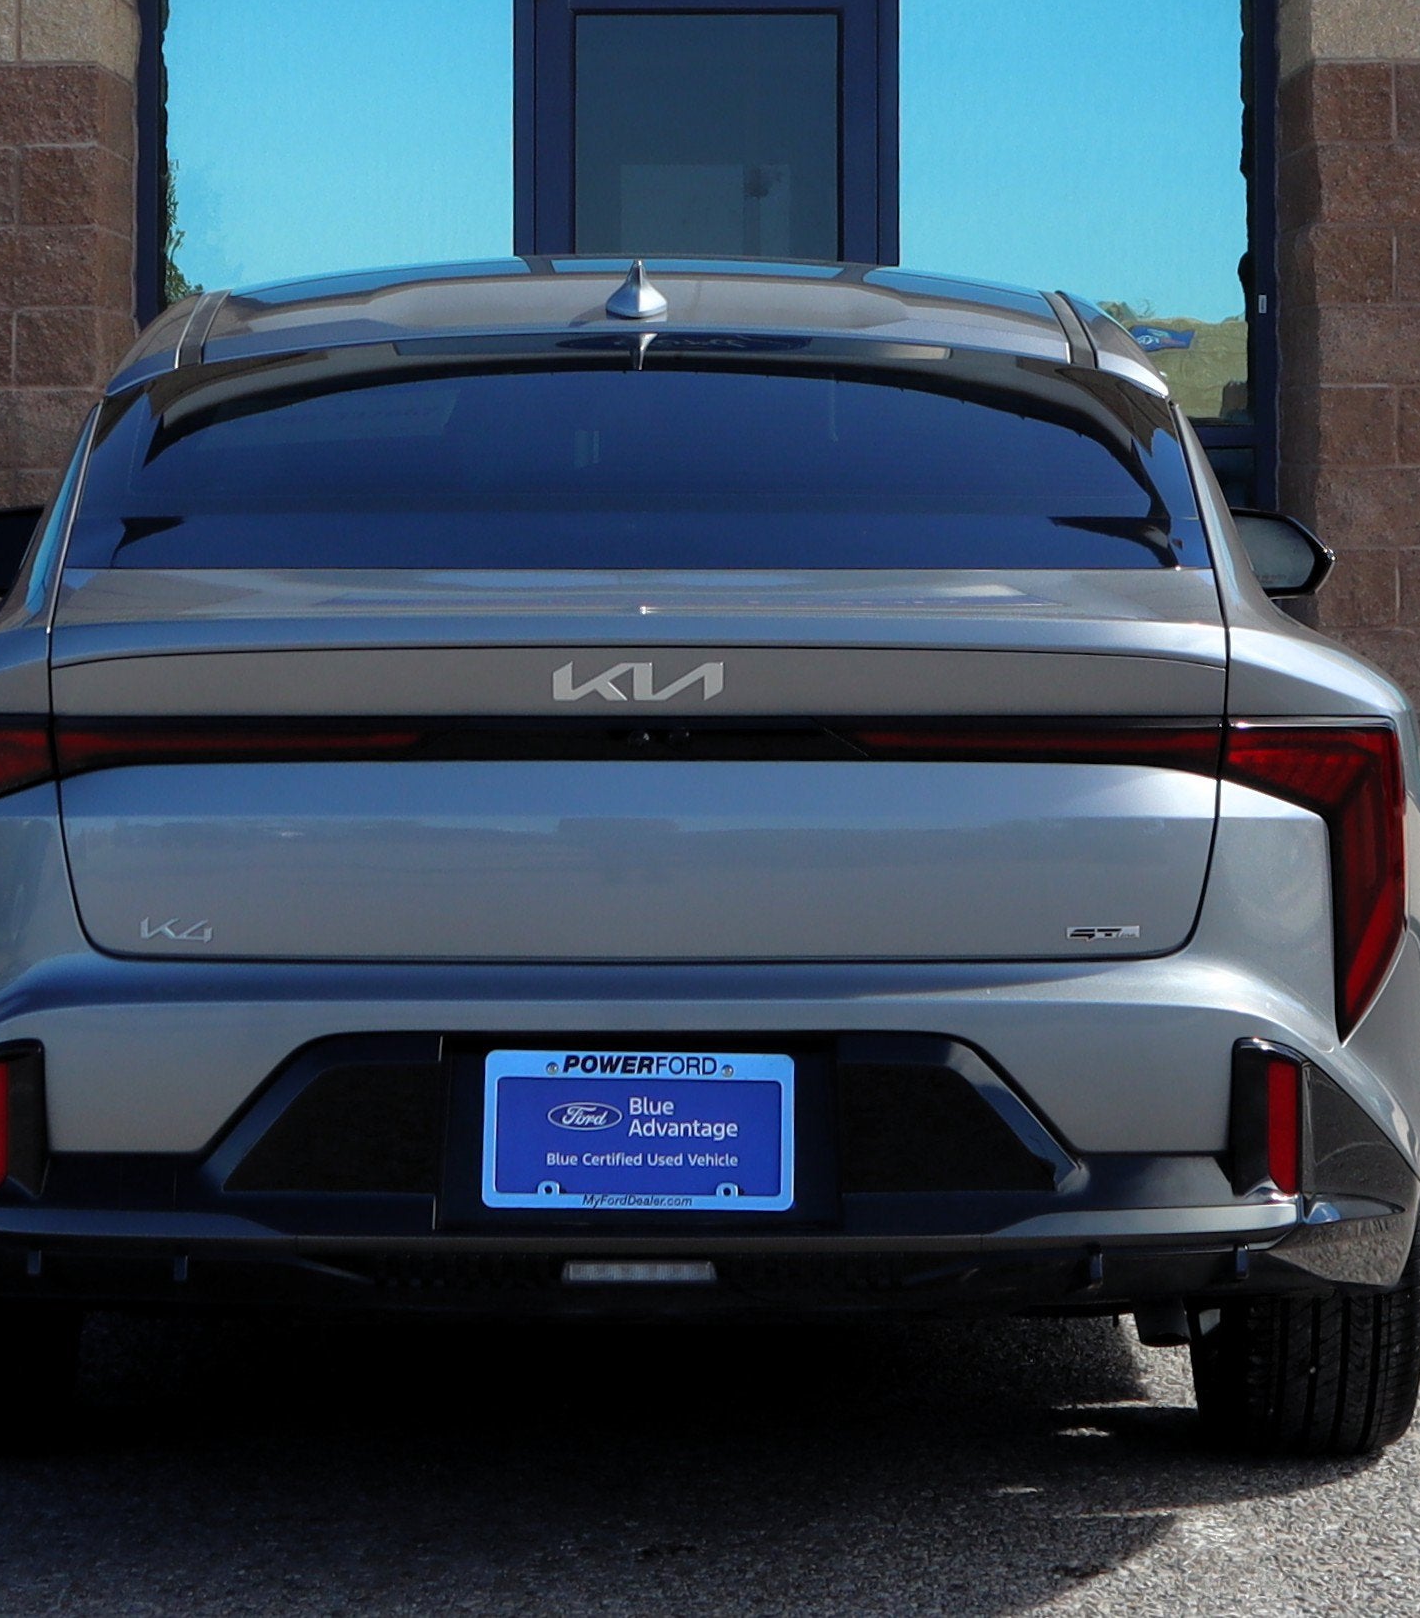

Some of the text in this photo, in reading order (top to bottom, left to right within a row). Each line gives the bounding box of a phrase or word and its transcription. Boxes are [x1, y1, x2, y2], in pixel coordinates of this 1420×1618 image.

[553, 661, 724, 701] KIA
[140, 916, 213, 944] K4
[563, 1055, 717, 1076] POWERFORD
[561, 1105, 608, 1126] Ford
[629, 1097, 674, 1116] Blue
[629, 1118, 738, 1141] Advantage
[546, 1152, 738, 1167] Blue Certified Used Vehicle
[582, 1194, 693, 1210] MyFordDealer.com
